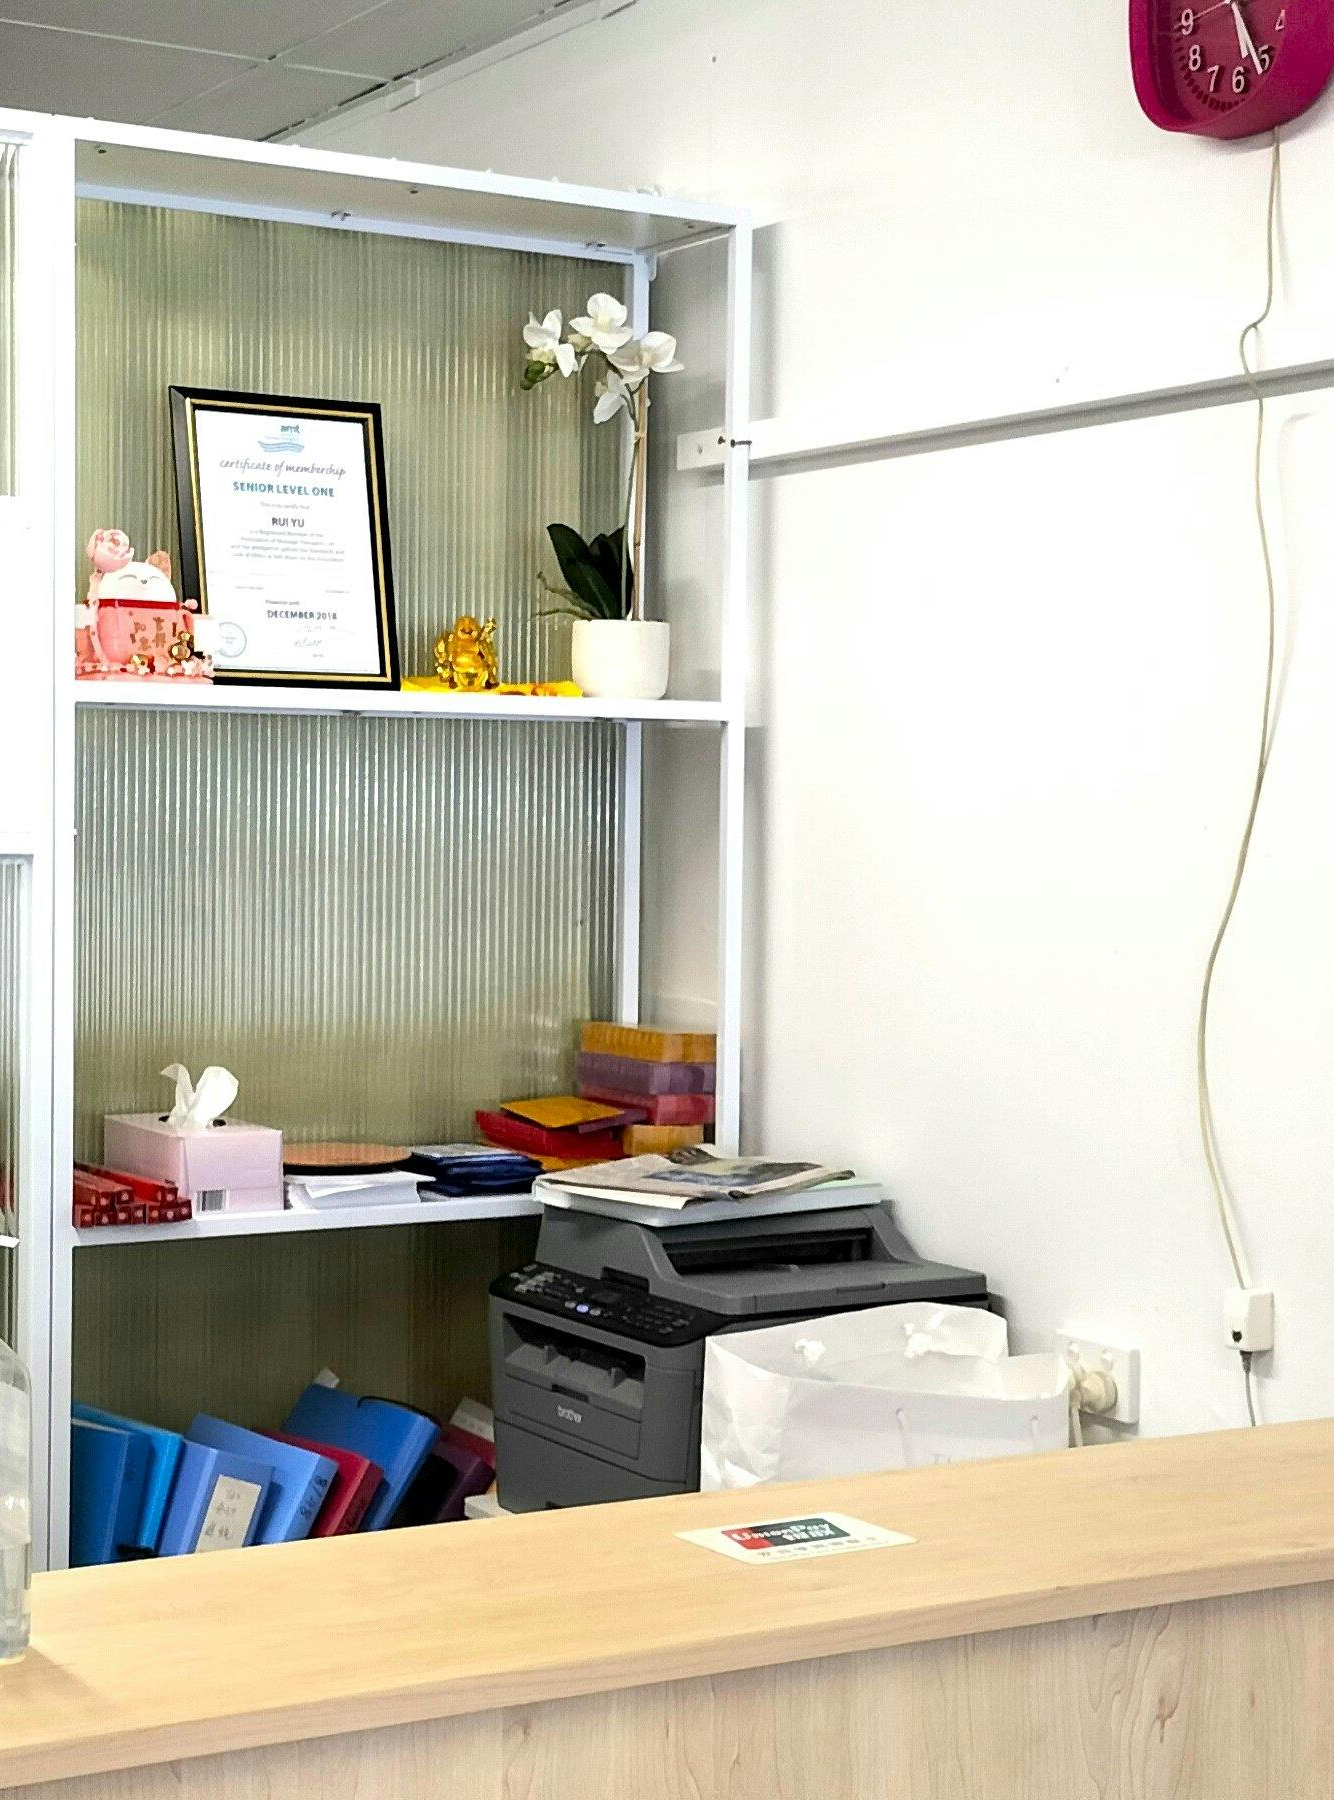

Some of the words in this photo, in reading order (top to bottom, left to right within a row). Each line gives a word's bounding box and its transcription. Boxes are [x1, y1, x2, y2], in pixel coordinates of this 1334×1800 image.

[1181, 9, 1194, 35] 9
[1188, 44, 1201, 71] 8
[1207, 65, 1220, 92] 7
[1232, 66, 1245, 93] 6
[220, 458, 271, 473] certificate
[275, 460, 285, 477] of
[286, 464, 346, 480] membership
[233, 481, 274, 493] SENIOR
[277, 485, 309, 495] LEVEL
[312, 487, 335, 497] ONE
[272, 517, 289, 527] RUI
[291, 518, 305, 528] YU
[267, 610, 315, 619] DECEMBER
